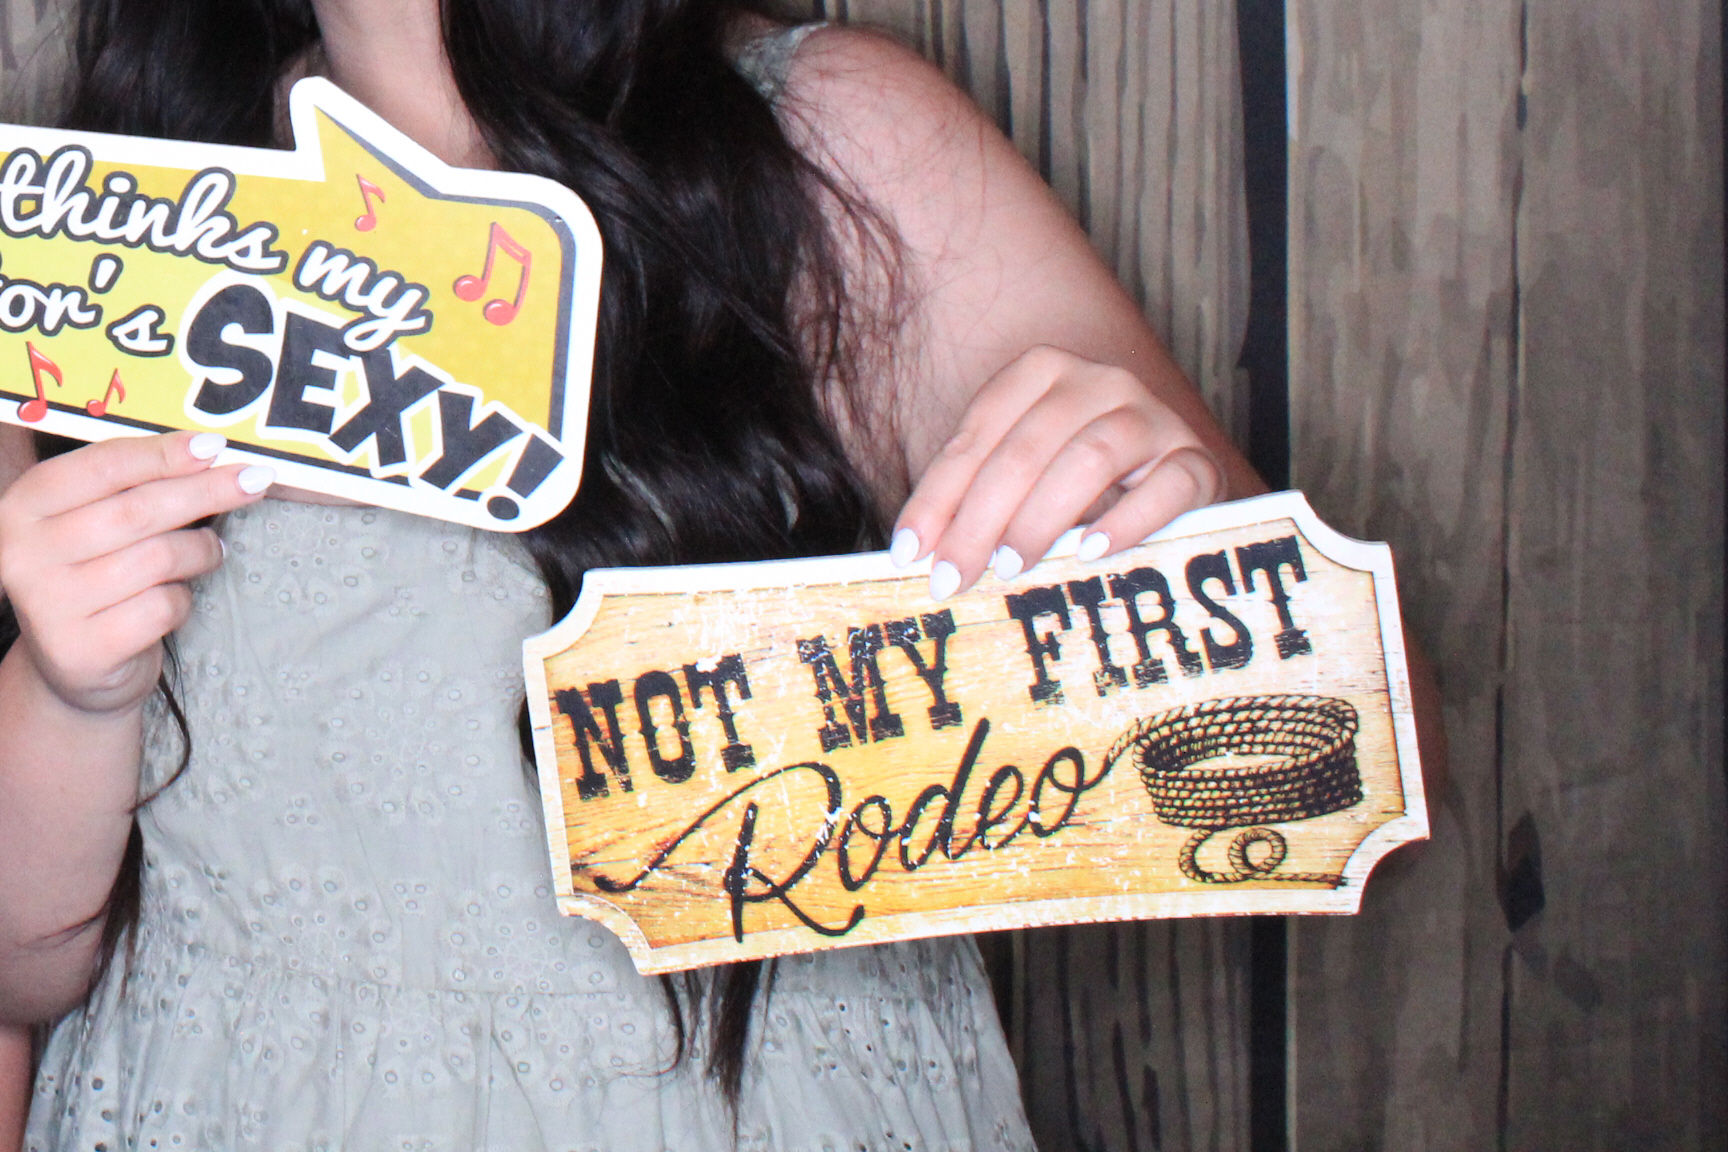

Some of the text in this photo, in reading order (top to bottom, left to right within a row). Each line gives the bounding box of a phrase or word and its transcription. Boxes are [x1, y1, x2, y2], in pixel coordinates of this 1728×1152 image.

[187, 283, 565, 521] SEXY!
[293, 239, 433, 352] my
[554, 535, 1312, 800] NOT MY FIRST
[593, 717, 1112, 943] Rodeo
